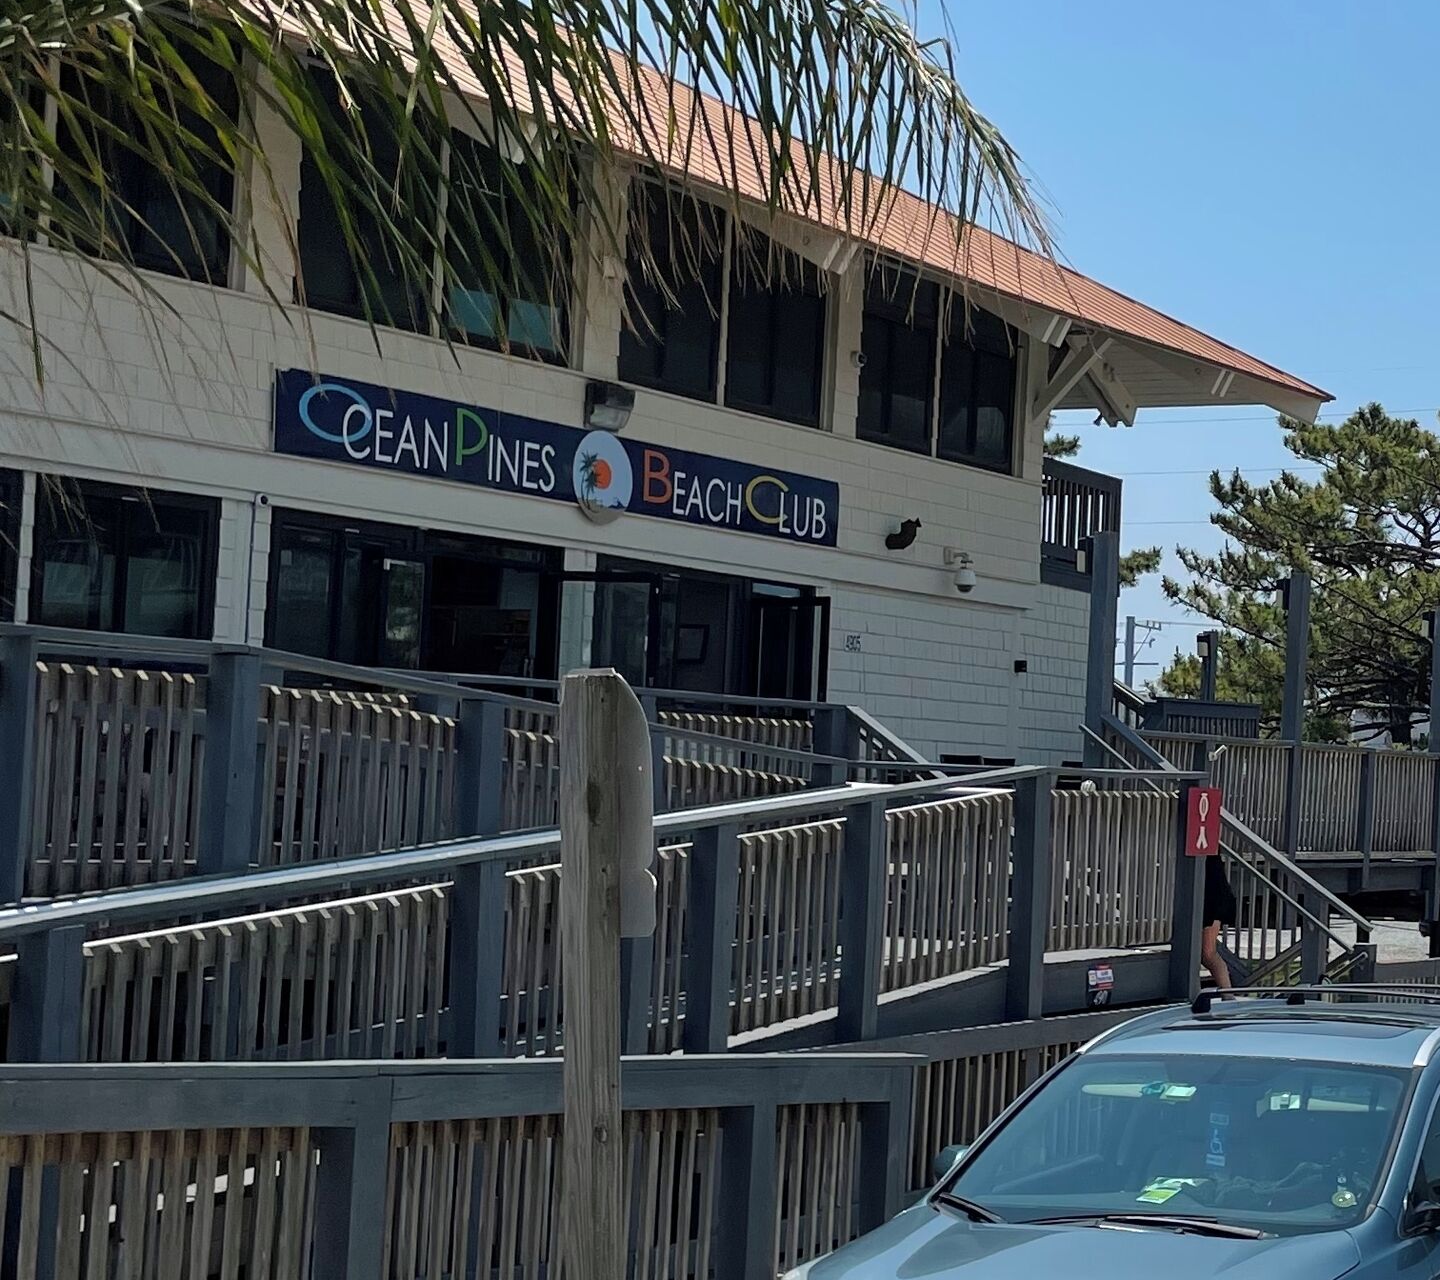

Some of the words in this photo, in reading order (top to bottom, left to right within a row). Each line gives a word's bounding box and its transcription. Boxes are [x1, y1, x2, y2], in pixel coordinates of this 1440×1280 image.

[299, 383, 448, 472] OCEAN
[456, 407, 555, 492] PINES
[642, 449, 743, 525] BEACH
[745, 475, 827, 539] CLUB
